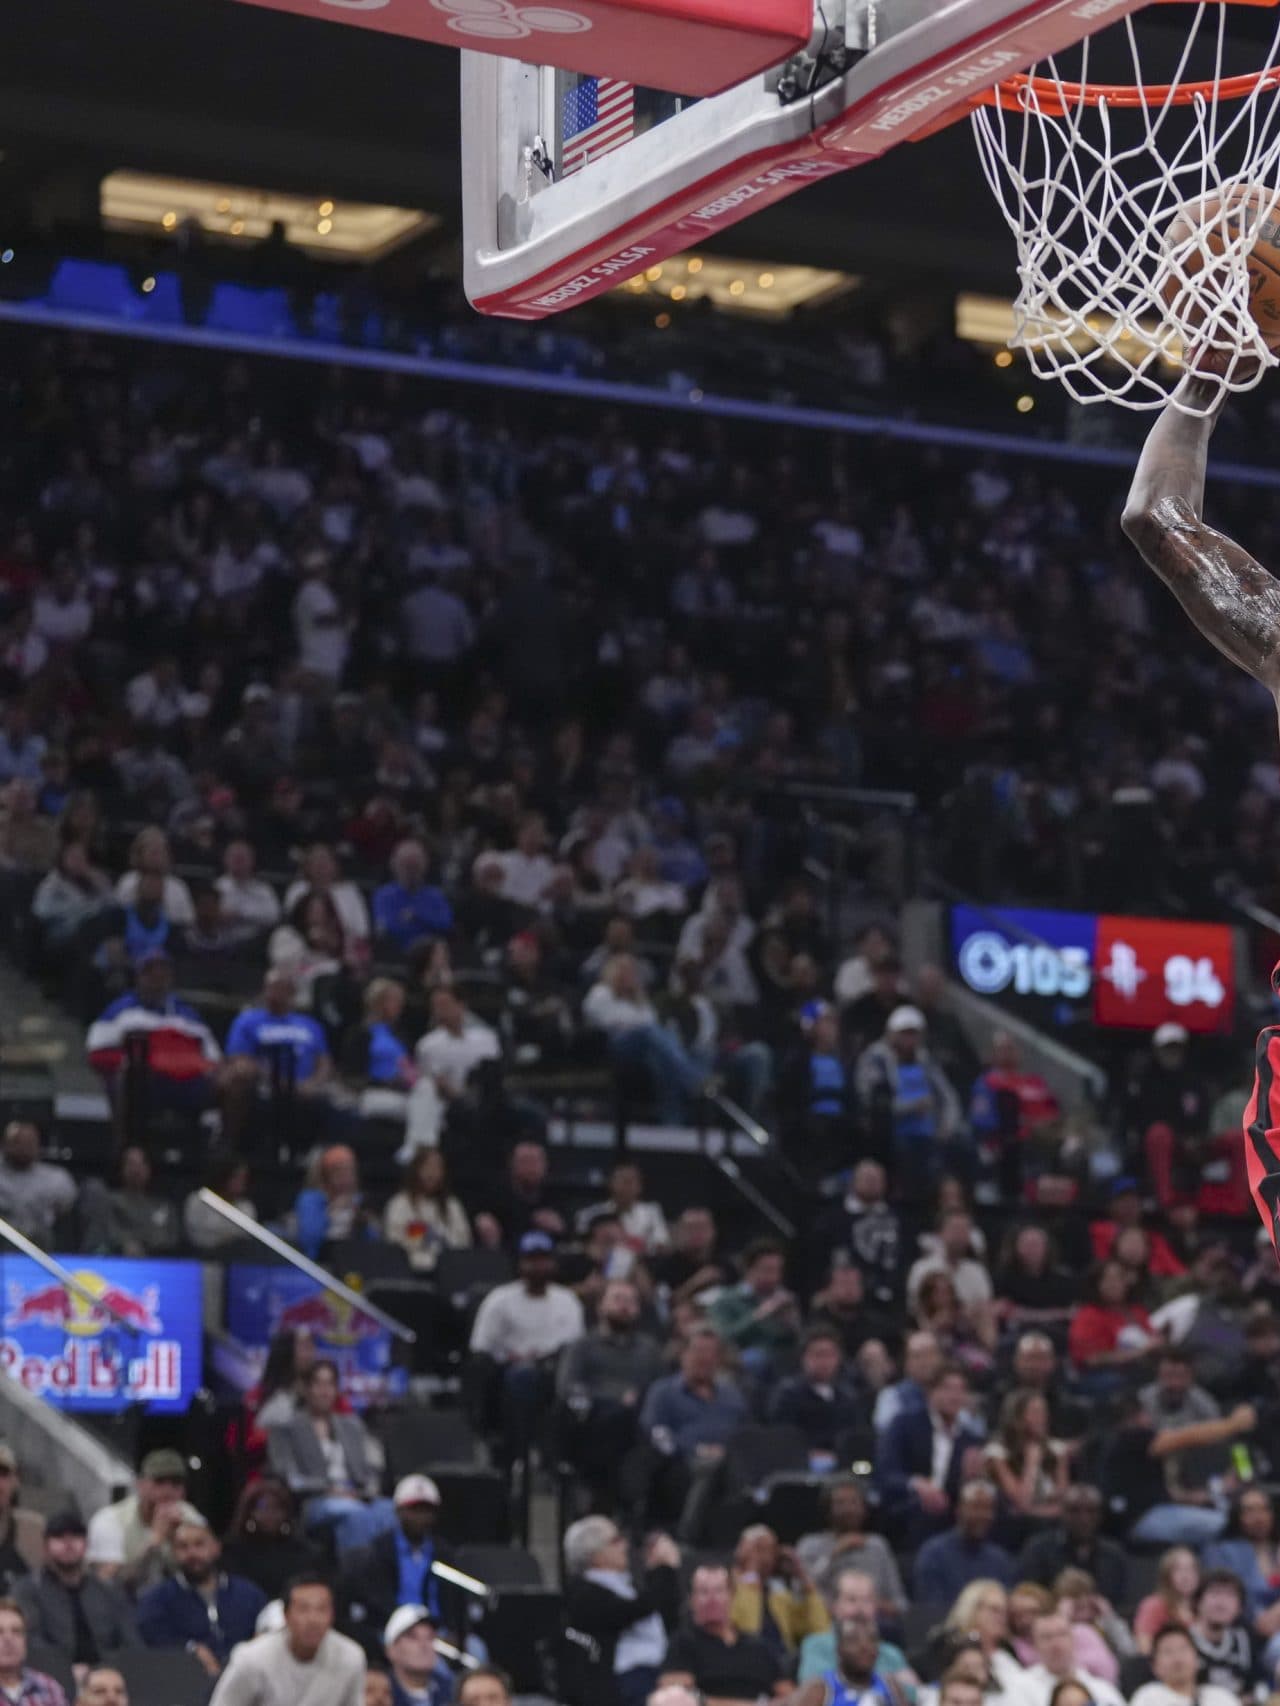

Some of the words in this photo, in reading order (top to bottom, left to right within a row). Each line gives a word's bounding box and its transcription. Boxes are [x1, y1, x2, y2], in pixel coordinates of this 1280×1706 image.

[869, 86, 952, 131] HERDEZ
[944, 50, 1021, 87] SALSA
[690, 184, 766, 219] HERDEZ
[531, 275, 601, 306] HERDEZ
[591, 246, 656, 275] SALSA
[1013, 944, 1091, 998] 105
[1164, 955, 1225, 1008] 94
